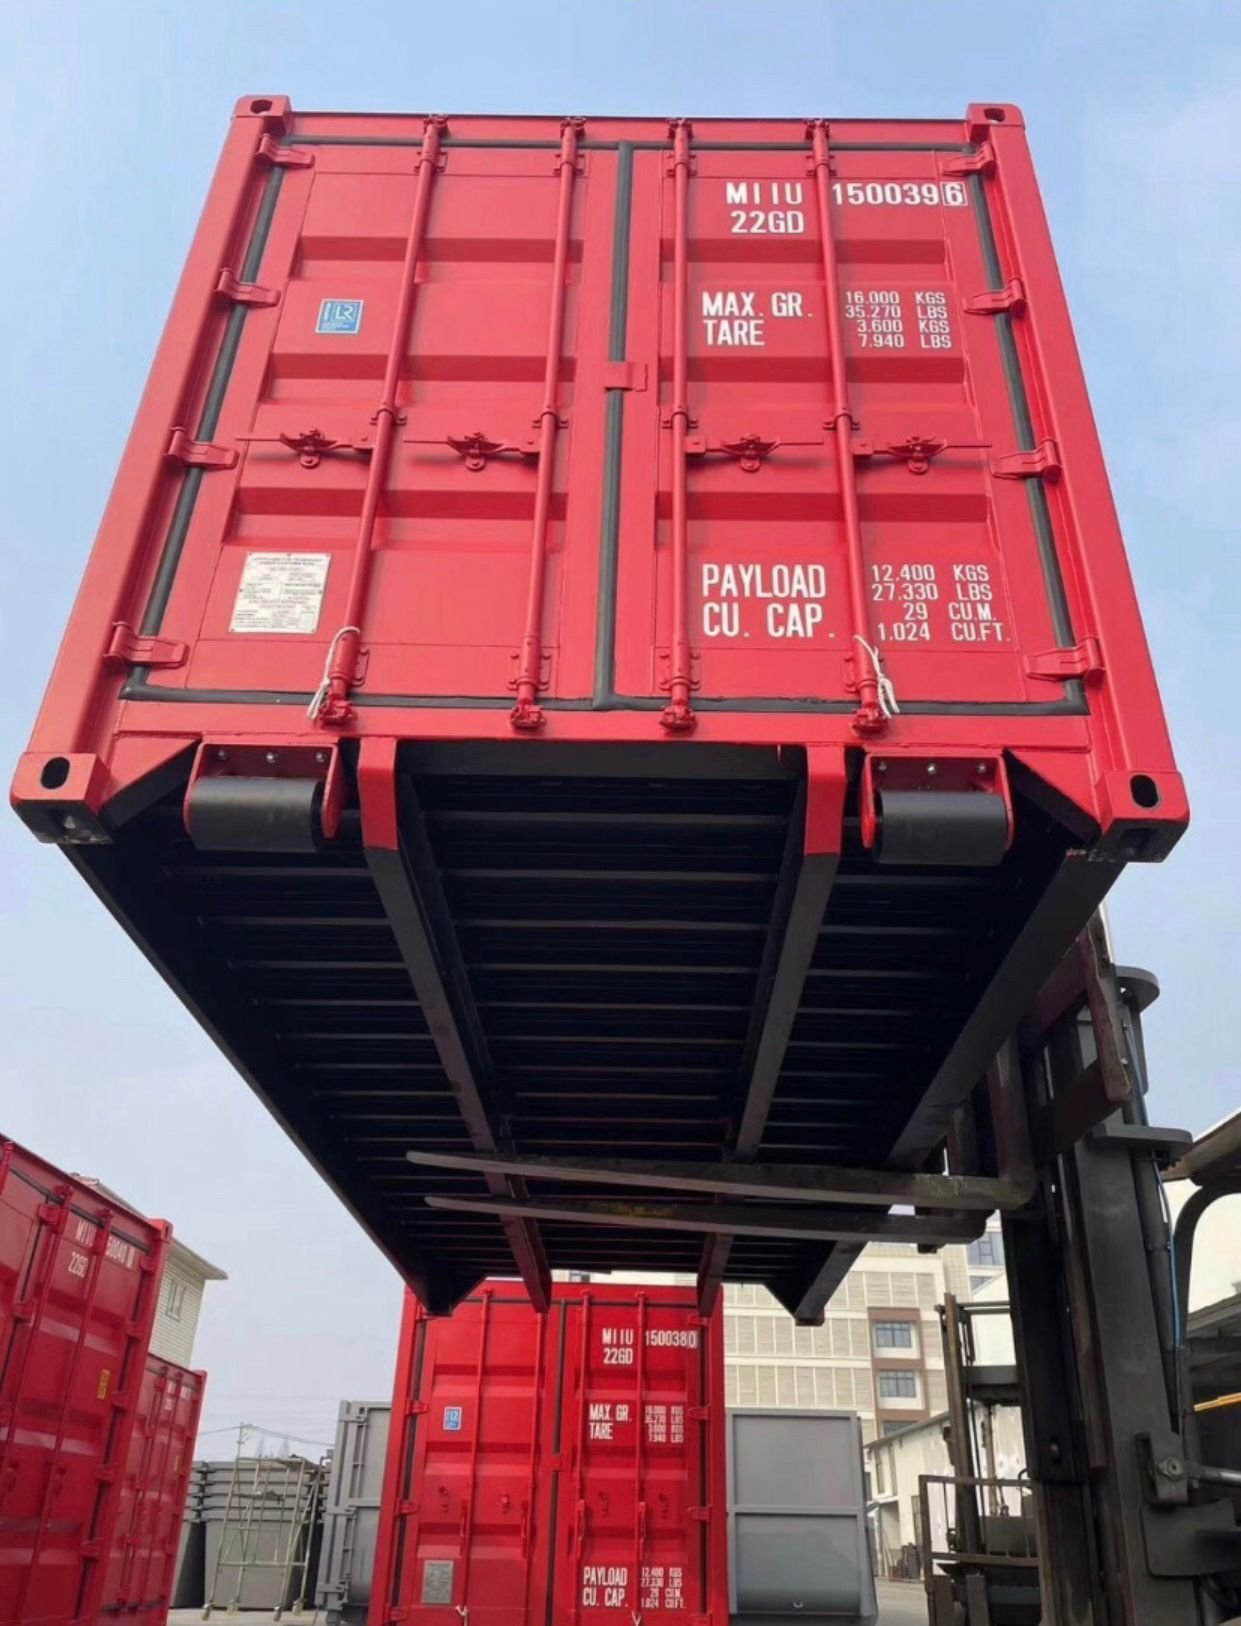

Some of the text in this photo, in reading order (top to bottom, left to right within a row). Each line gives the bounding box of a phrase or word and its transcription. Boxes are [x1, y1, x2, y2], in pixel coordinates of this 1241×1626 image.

[725, 182, 967, 206] MIIU 1500396
[730, 211, 804, 234] 22GD
[702, 291, 813, 317] MAX. GR.
[845, 291, 945, 304] 16.000 KGS
[845, 305, 948, 319] 35.270 LBS
[703, 319, 765, 346] TARE
[857, 319, 949, 333] 3.600 KGS
[859, 334, 951, 349] 7.940 LBS
[702, 563, 826, 598] PAYLOAD
[871, 564, 989, 581] 12.400 KGS
[871, 583, 992, 601] 27.330 LBS
[702, 602, 835, 638] CU. CAP.
[903, 602, 928, 621] 29
[877, 622, 931, 641] 1.024
[602, 1328, 634, 1345] MIIU
[603, 1347, 634, 1365] 22GD
[589, 1422, 613, 1440] TARE
[583, 1566, 628, 1586] PAYLOAD
